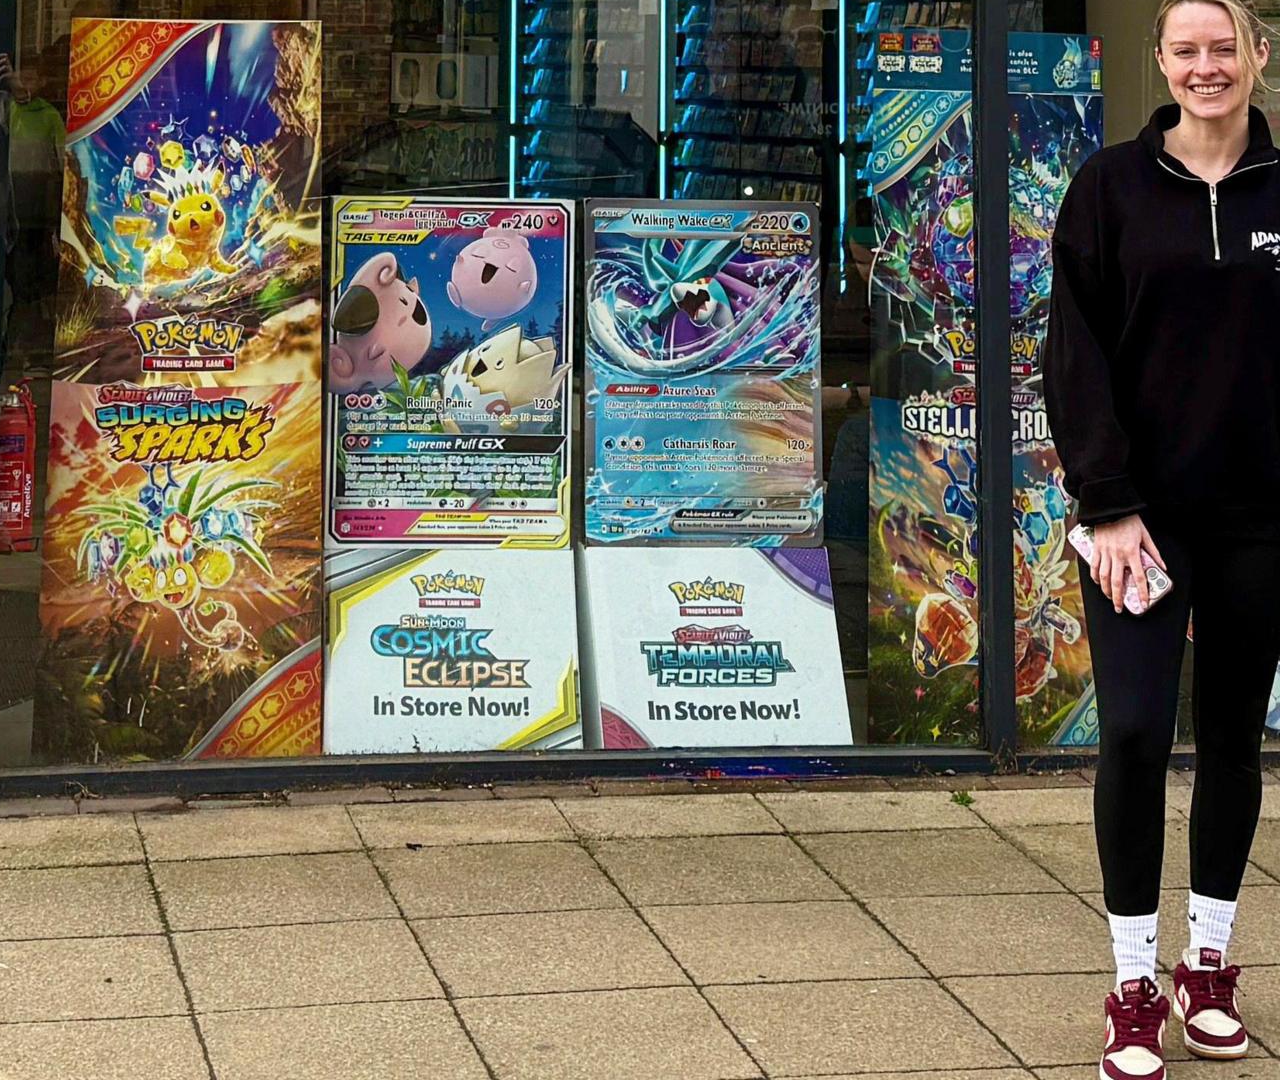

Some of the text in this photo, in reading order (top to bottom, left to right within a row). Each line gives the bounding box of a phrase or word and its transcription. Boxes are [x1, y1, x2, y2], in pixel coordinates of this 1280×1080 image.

[512, 214, 544, 230] 240
[631, 213, 675, 229] Walking
[678, 214, 709, 227] Wake
[760, 215, 789, 231] 220
[345, 232, 419, 242] TAG TEAM
[751, 239, 806, 253] Ancient
[615, 385, 651, 395] Ability
[662, 385, 716, 397] Azure Seas
[406, 397, 443, 411] Rolling
[445, 398, 473, 409] Panic
[96, 398, 247, 428] SURGING
[111, 410, 274, 463] SPARKS
[405, 437, 507, 452] Supreme Puff GX
[662, 438, 711, 451] Catharsis
[712, 439, 737, 450] Roar
[371, 624, 494, 659] COSMIC
[642, 642, 792, 671] TEMPORAL
[404, 657, 530, 688] ECLIPSE
[660, 668, 774, 684] FORCES
[373, 695, 531, 717] In Store Now!
[647, 698, 801, 721] In Store Now!
